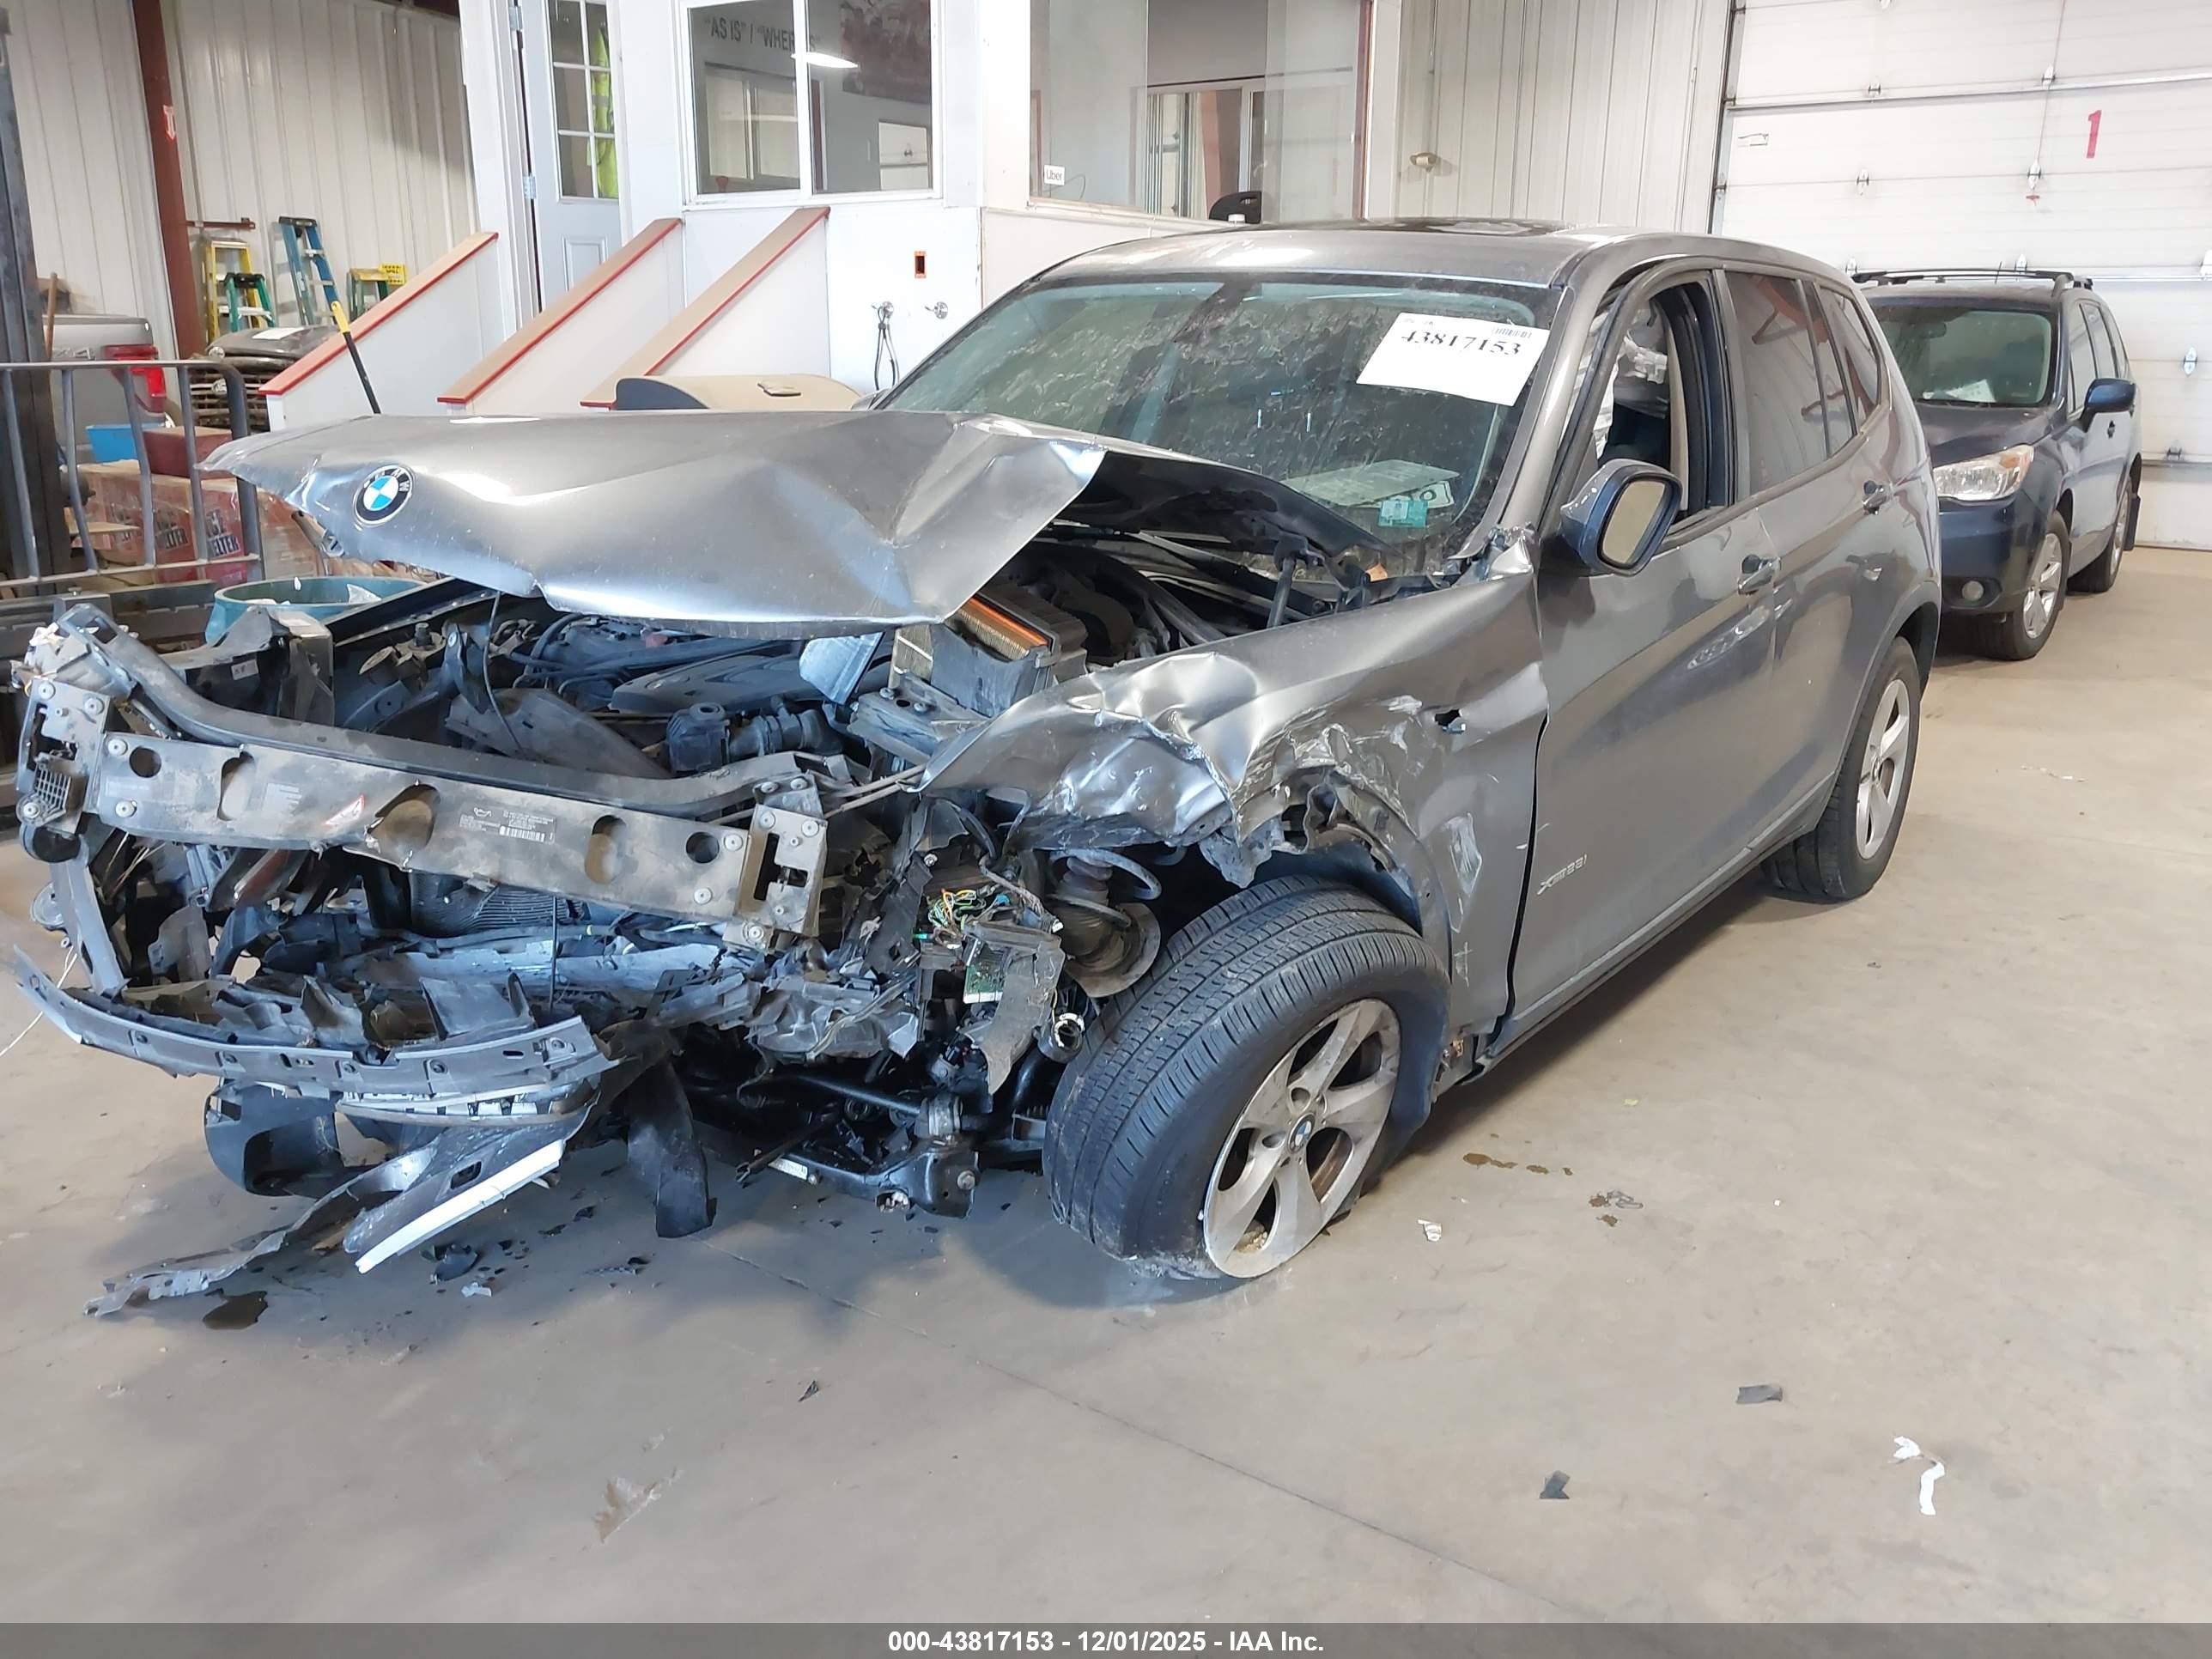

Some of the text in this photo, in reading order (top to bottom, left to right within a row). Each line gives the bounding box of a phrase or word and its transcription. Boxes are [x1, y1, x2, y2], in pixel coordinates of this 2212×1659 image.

[757, 25, 794, 52] "WHER
[2086, 109, 2102, 159] 1
[1046, 168, 1063, 181] Uber
[1401, 330, 1522, 356] 43817153
